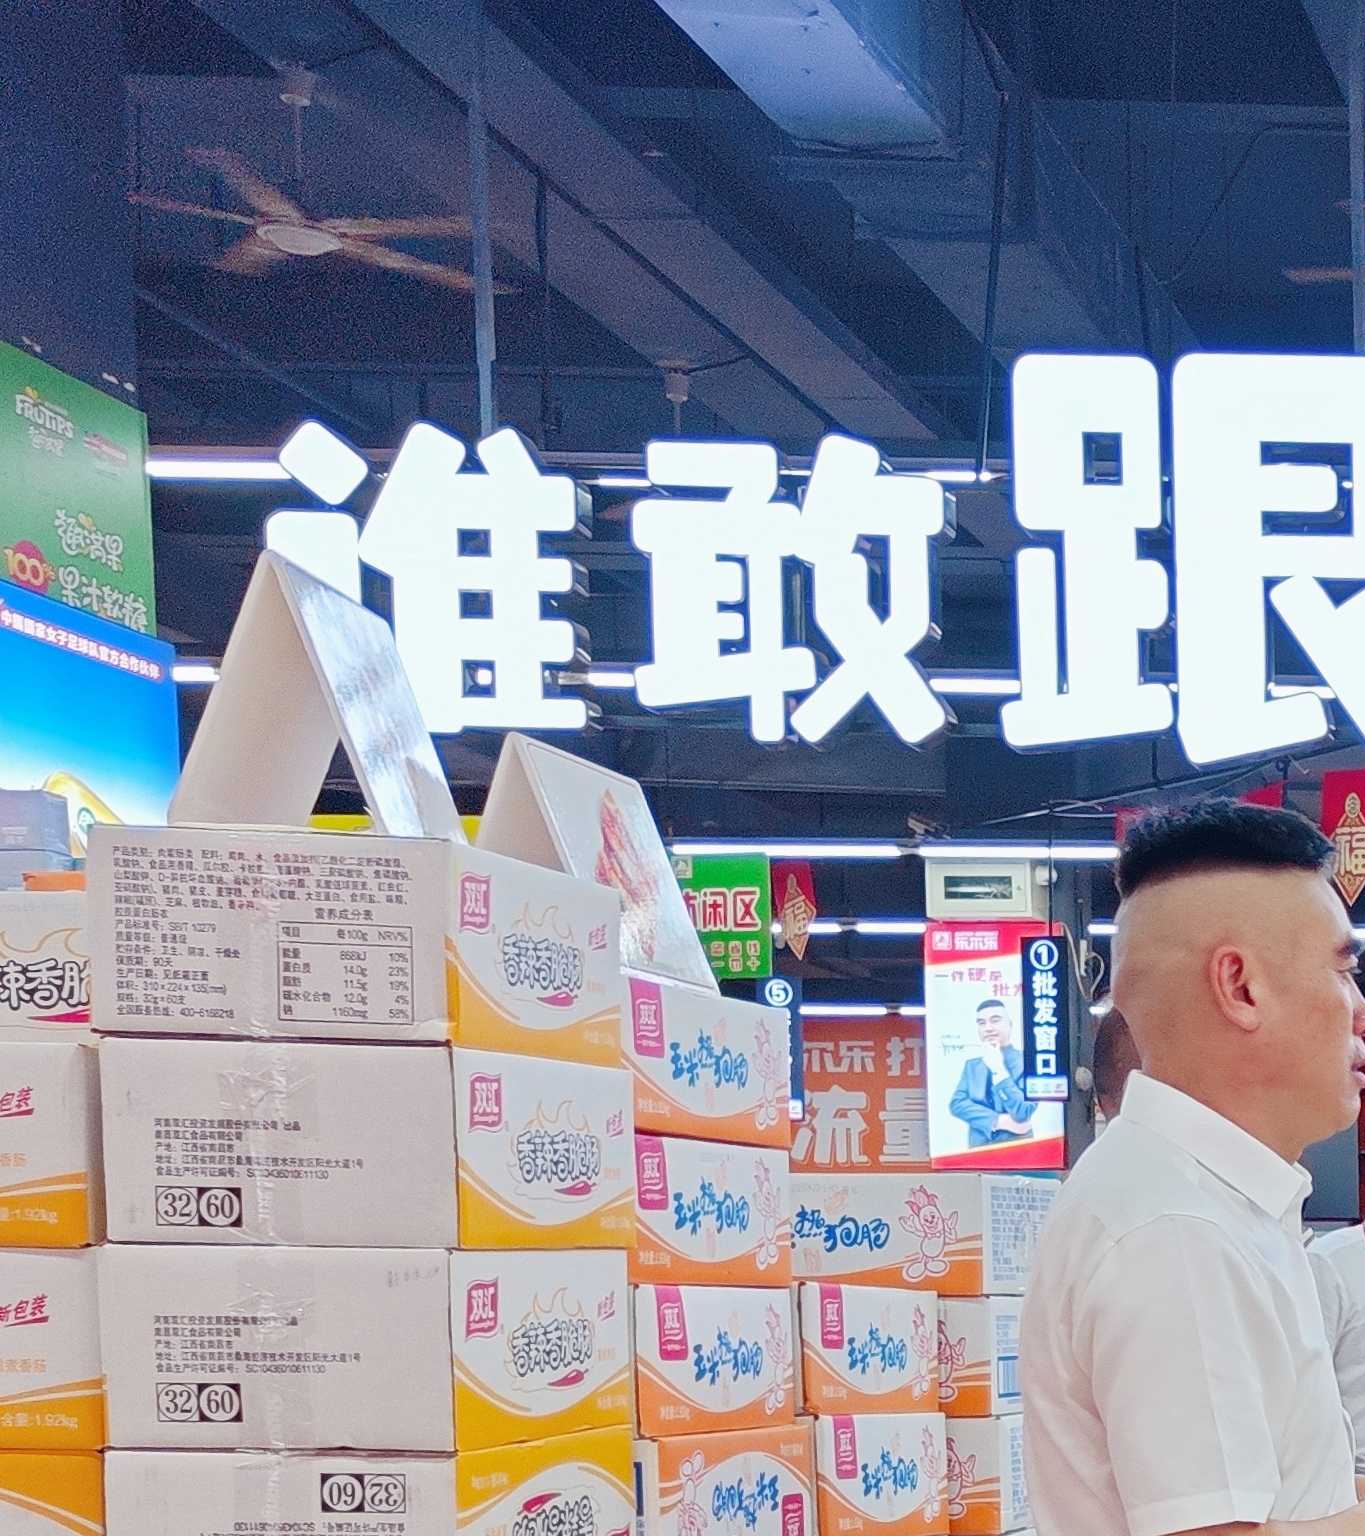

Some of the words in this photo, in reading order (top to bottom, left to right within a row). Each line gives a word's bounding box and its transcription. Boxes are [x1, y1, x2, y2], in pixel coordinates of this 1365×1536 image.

[15, 393, 75, 439] FRUTIPS
[57, 564, 149, 634] 果汁软糖
[502, 934, 583, 990] 香辣香脆肠
[791, 1085, 930, 1167] 流量
[516, 1129, 600, 1183] 香辣香脆肠
[163, 1193, 194, 1218] 32
[206, 1193, 234, 1218] 60
[512, 1318, 593, 1376] 香辣香脆肠
[164, 1389, 193, 1414] 32
[206, 1389, 235, 1414] 60
[328, 1481, 357, 1506] 60
[369, 1481, 398, 1506] 32
